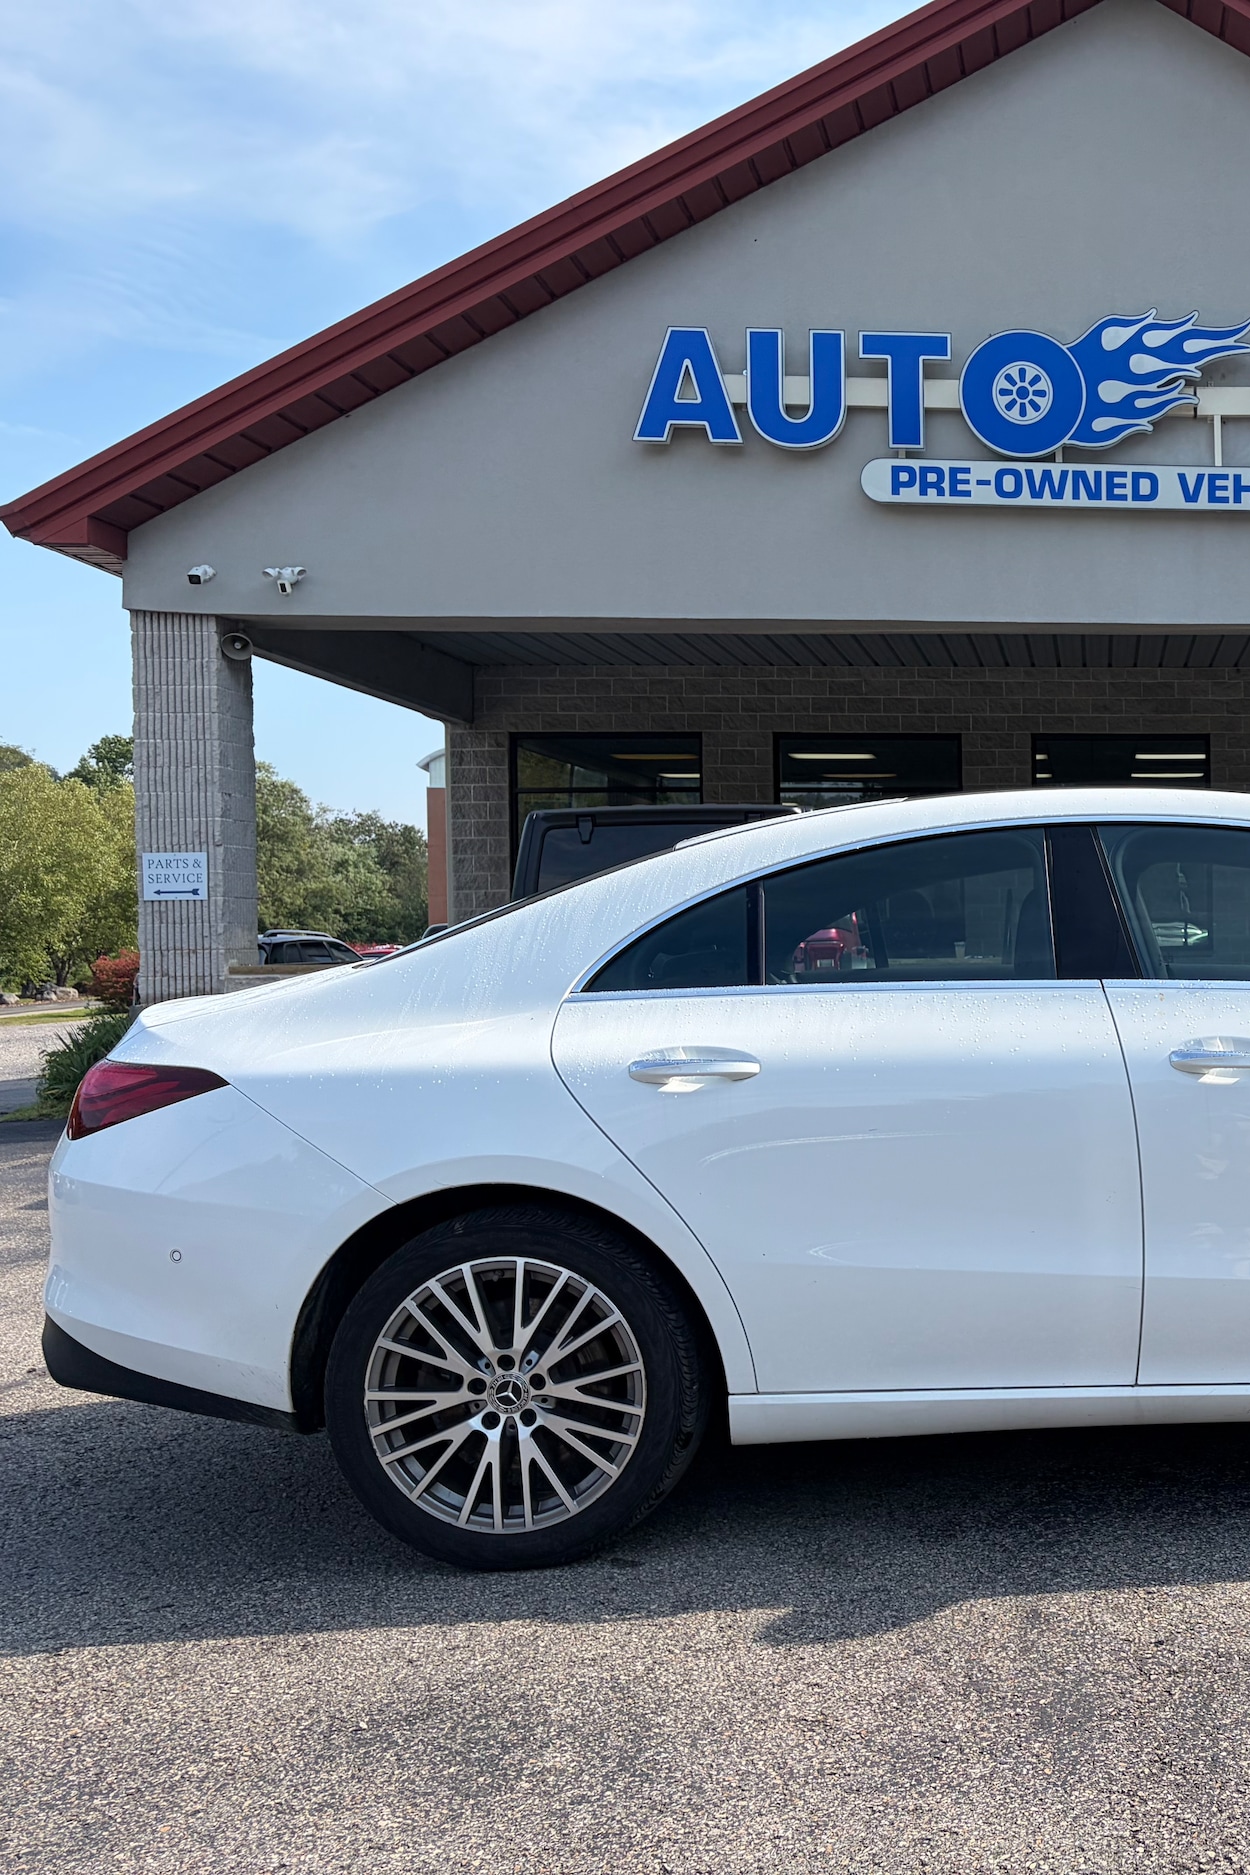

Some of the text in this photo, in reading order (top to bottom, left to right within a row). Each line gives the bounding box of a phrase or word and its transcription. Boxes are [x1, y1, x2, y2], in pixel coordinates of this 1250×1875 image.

[632, 325, 1088, 459] AUTO
[890, 464, 1159, 503] PRE-OWNED
[147, 858, 202, 869] PARTS &
[147, 873, 203, 884] SERVICE
